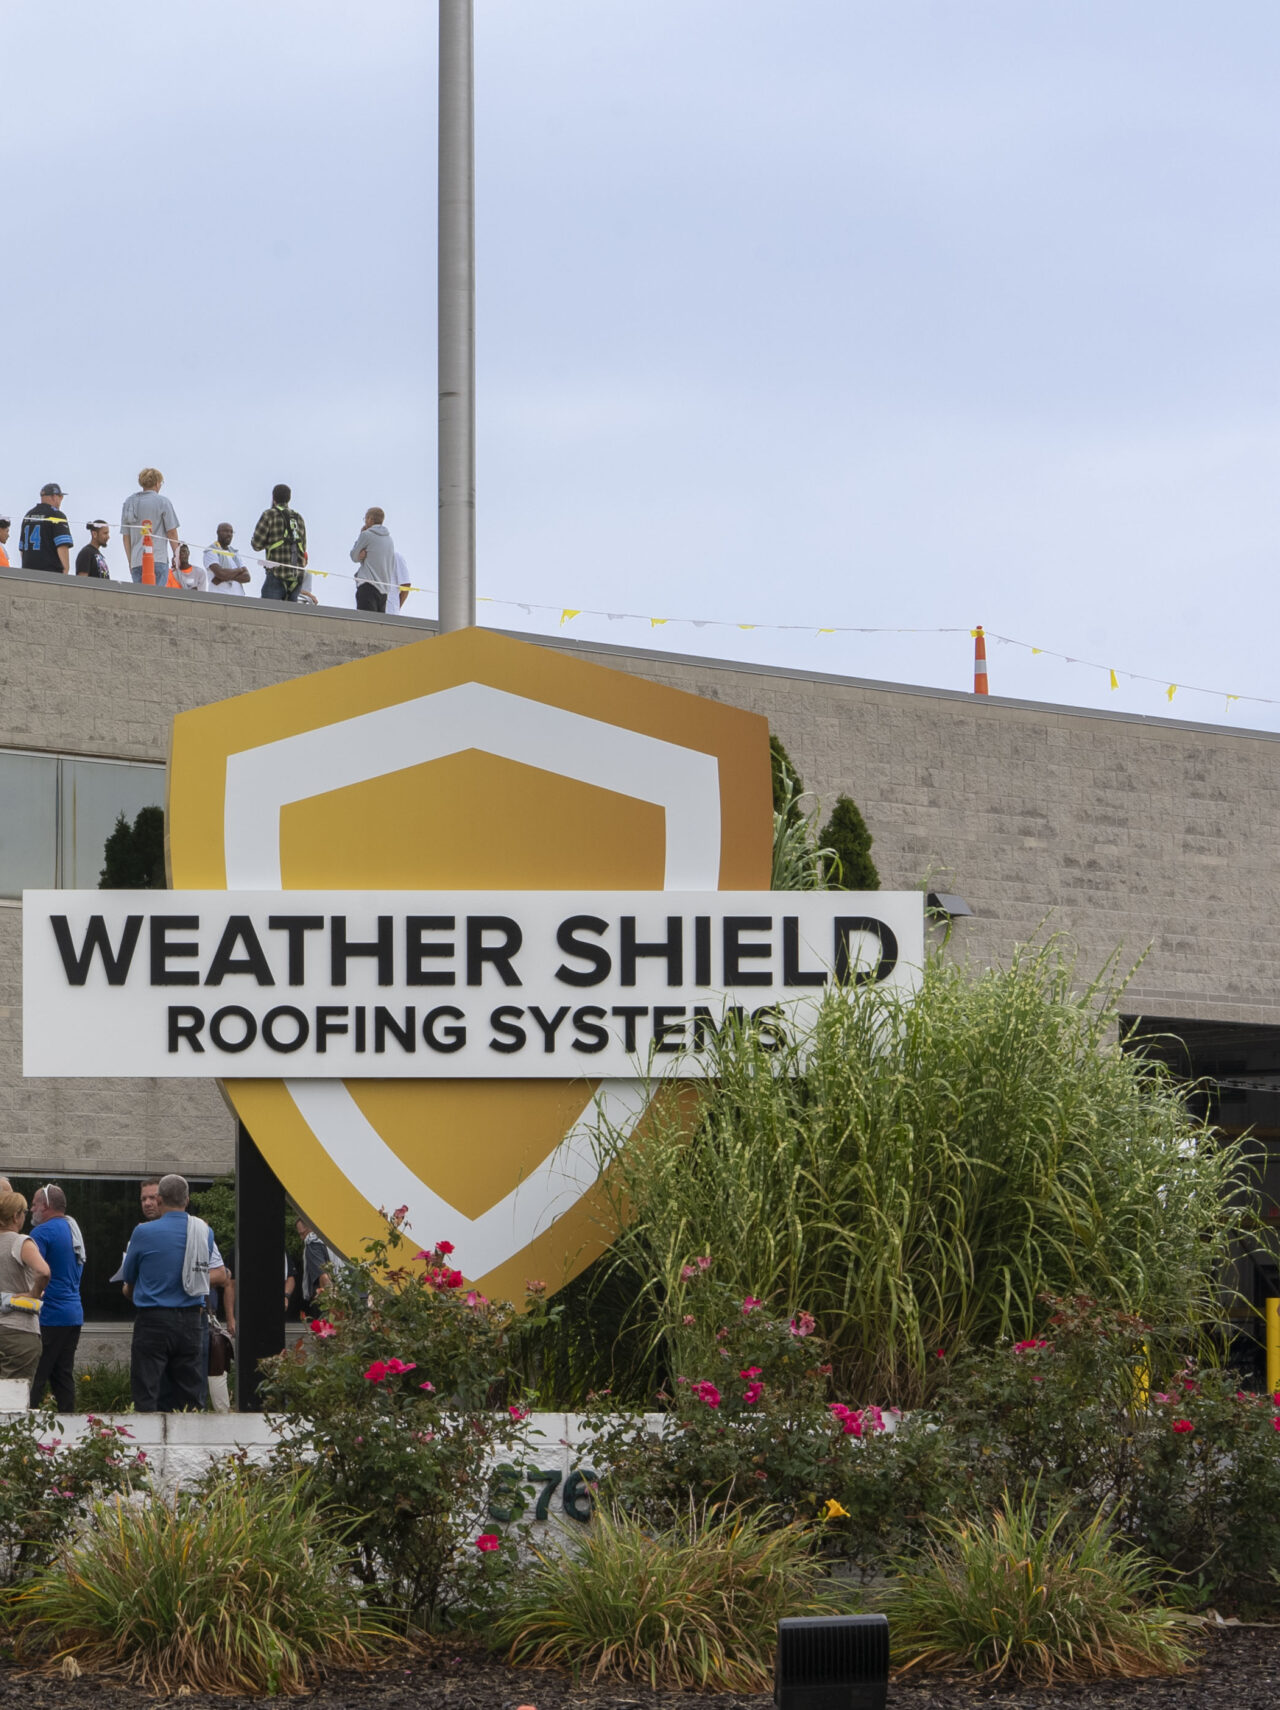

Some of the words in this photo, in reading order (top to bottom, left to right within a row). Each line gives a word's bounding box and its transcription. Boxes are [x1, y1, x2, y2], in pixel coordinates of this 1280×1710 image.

[24, 524, 41, 551] 14
[50, 915, 523, 987] WEATHER
[555, 915, 899, 987] SHIELD
[168, 1005, 467, 1054] ROOFING
